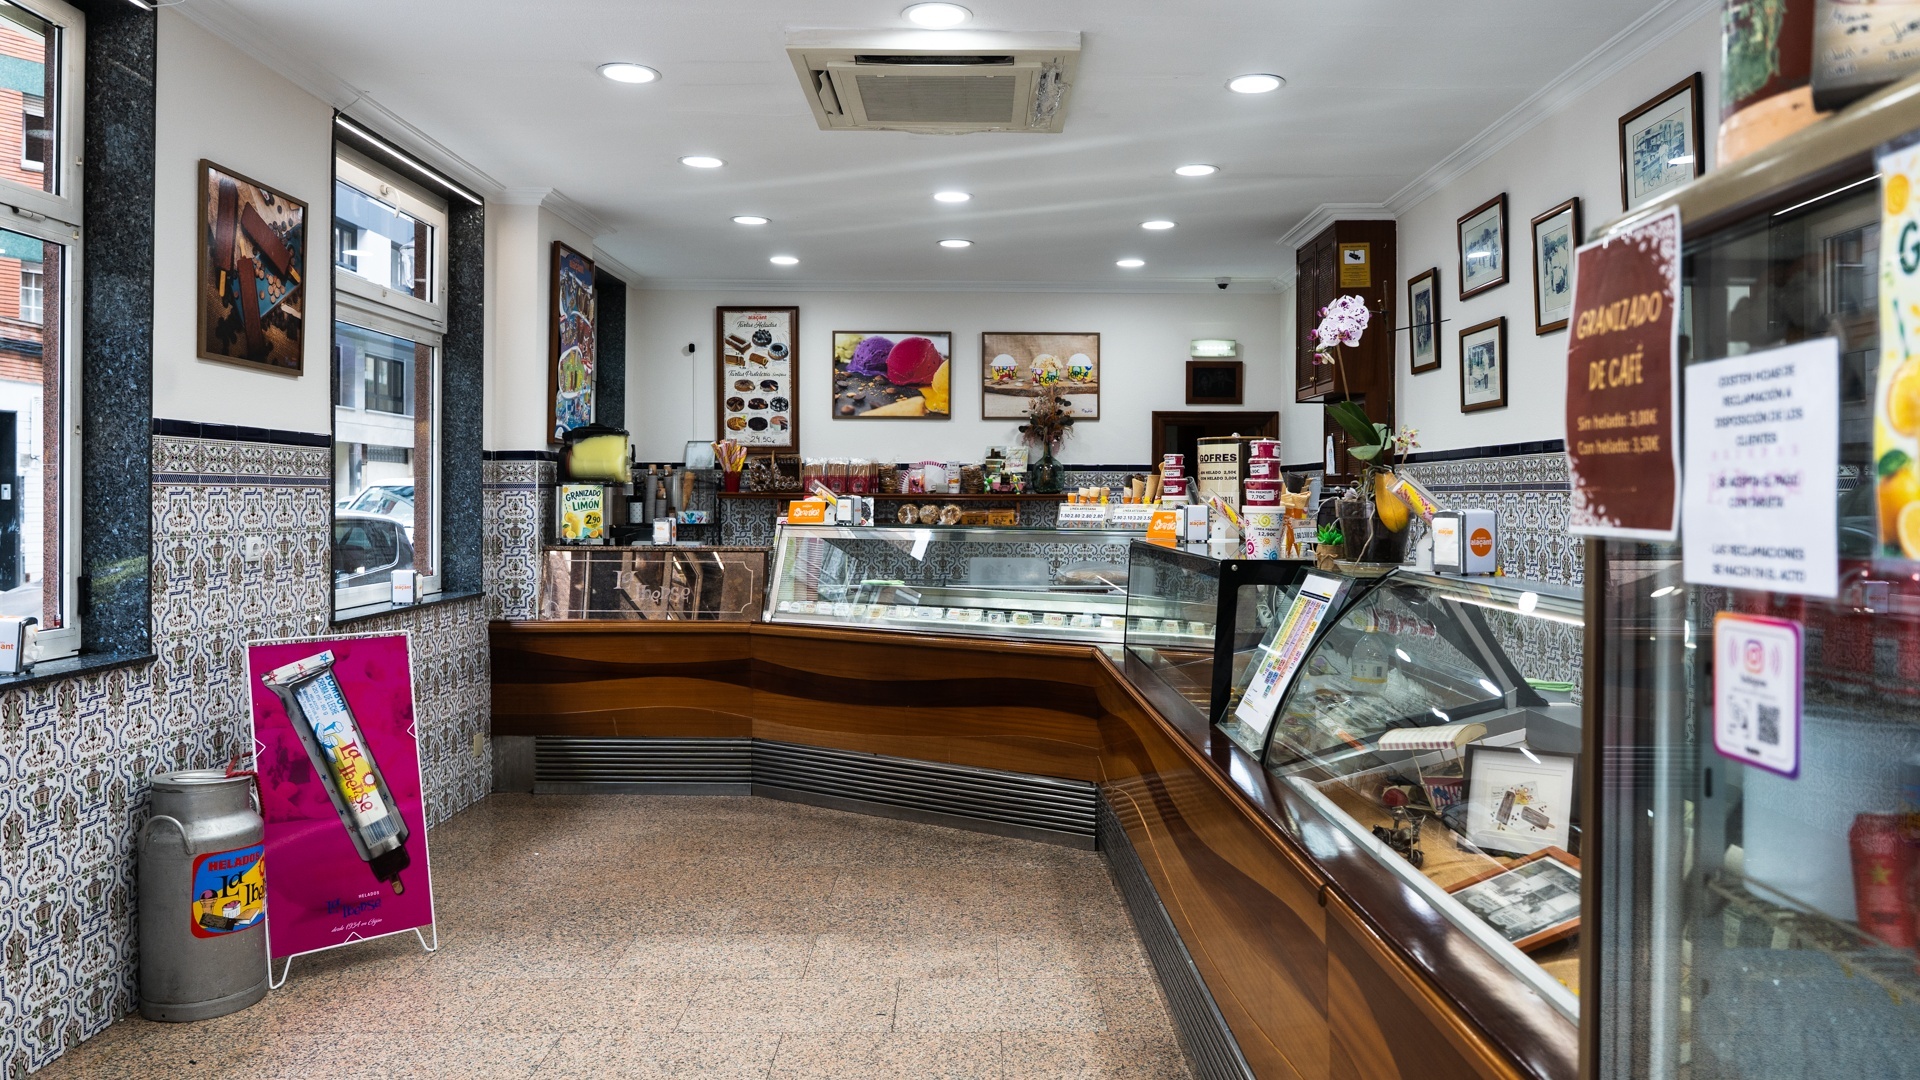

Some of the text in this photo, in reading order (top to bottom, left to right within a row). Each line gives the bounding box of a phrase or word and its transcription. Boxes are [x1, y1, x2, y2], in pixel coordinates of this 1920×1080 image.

[1577, 291, 1662, 340] GRANIZADO
[1588, 344, 1643, 391] DE CAFÉ
[1577, 416, 1591, 431] Sin
[1577, 441, 1593, 455] Con
[1200, 453, 1237, 462] GOFRES
[566, 489, 601, 502] GRANIZADO
[572, 498, 600, 511] LIMÓN
[208, 851, 260, 871] HELADOS
